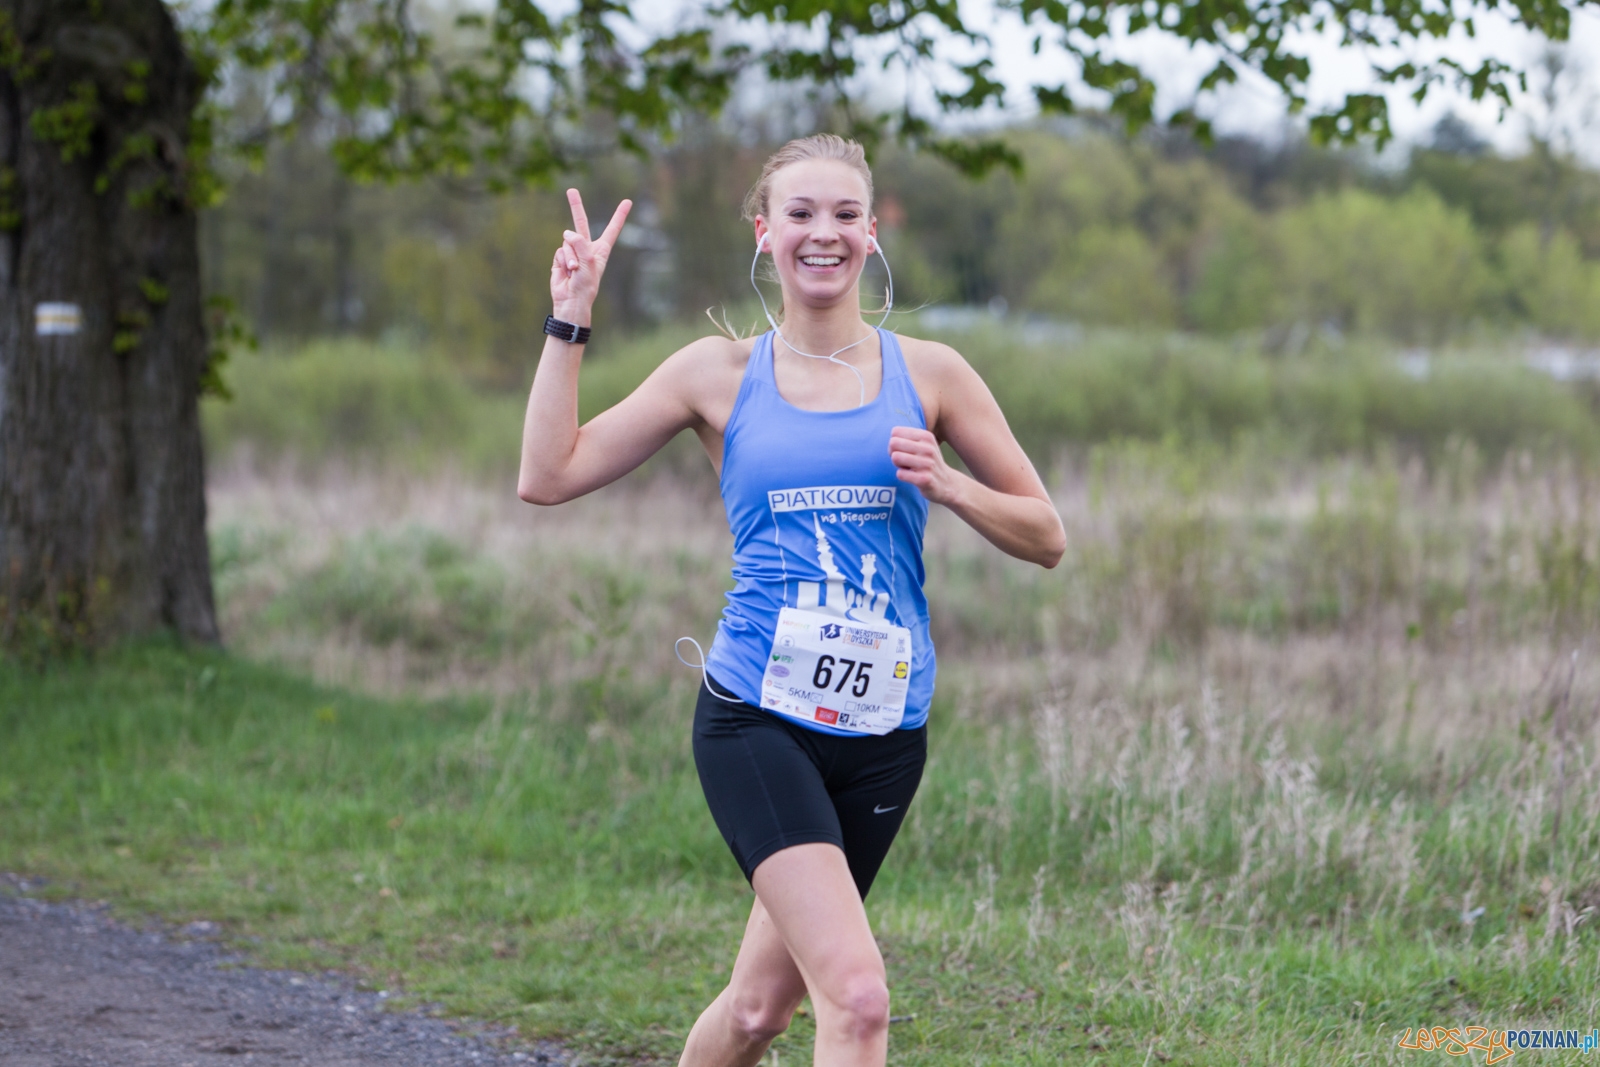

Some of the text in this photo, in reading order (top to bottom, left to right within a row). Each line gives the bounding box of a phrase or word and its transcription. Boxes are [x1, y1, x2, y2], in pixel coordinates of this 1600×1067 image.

[771, 488, 893, 508] PIATKOWO
[820, 511, 888, 527] na biegowo
[812, 654, 873, 698] 675
[788, 687, 811, 700] 5KM
[856, 702, 880, 714] 10KM
